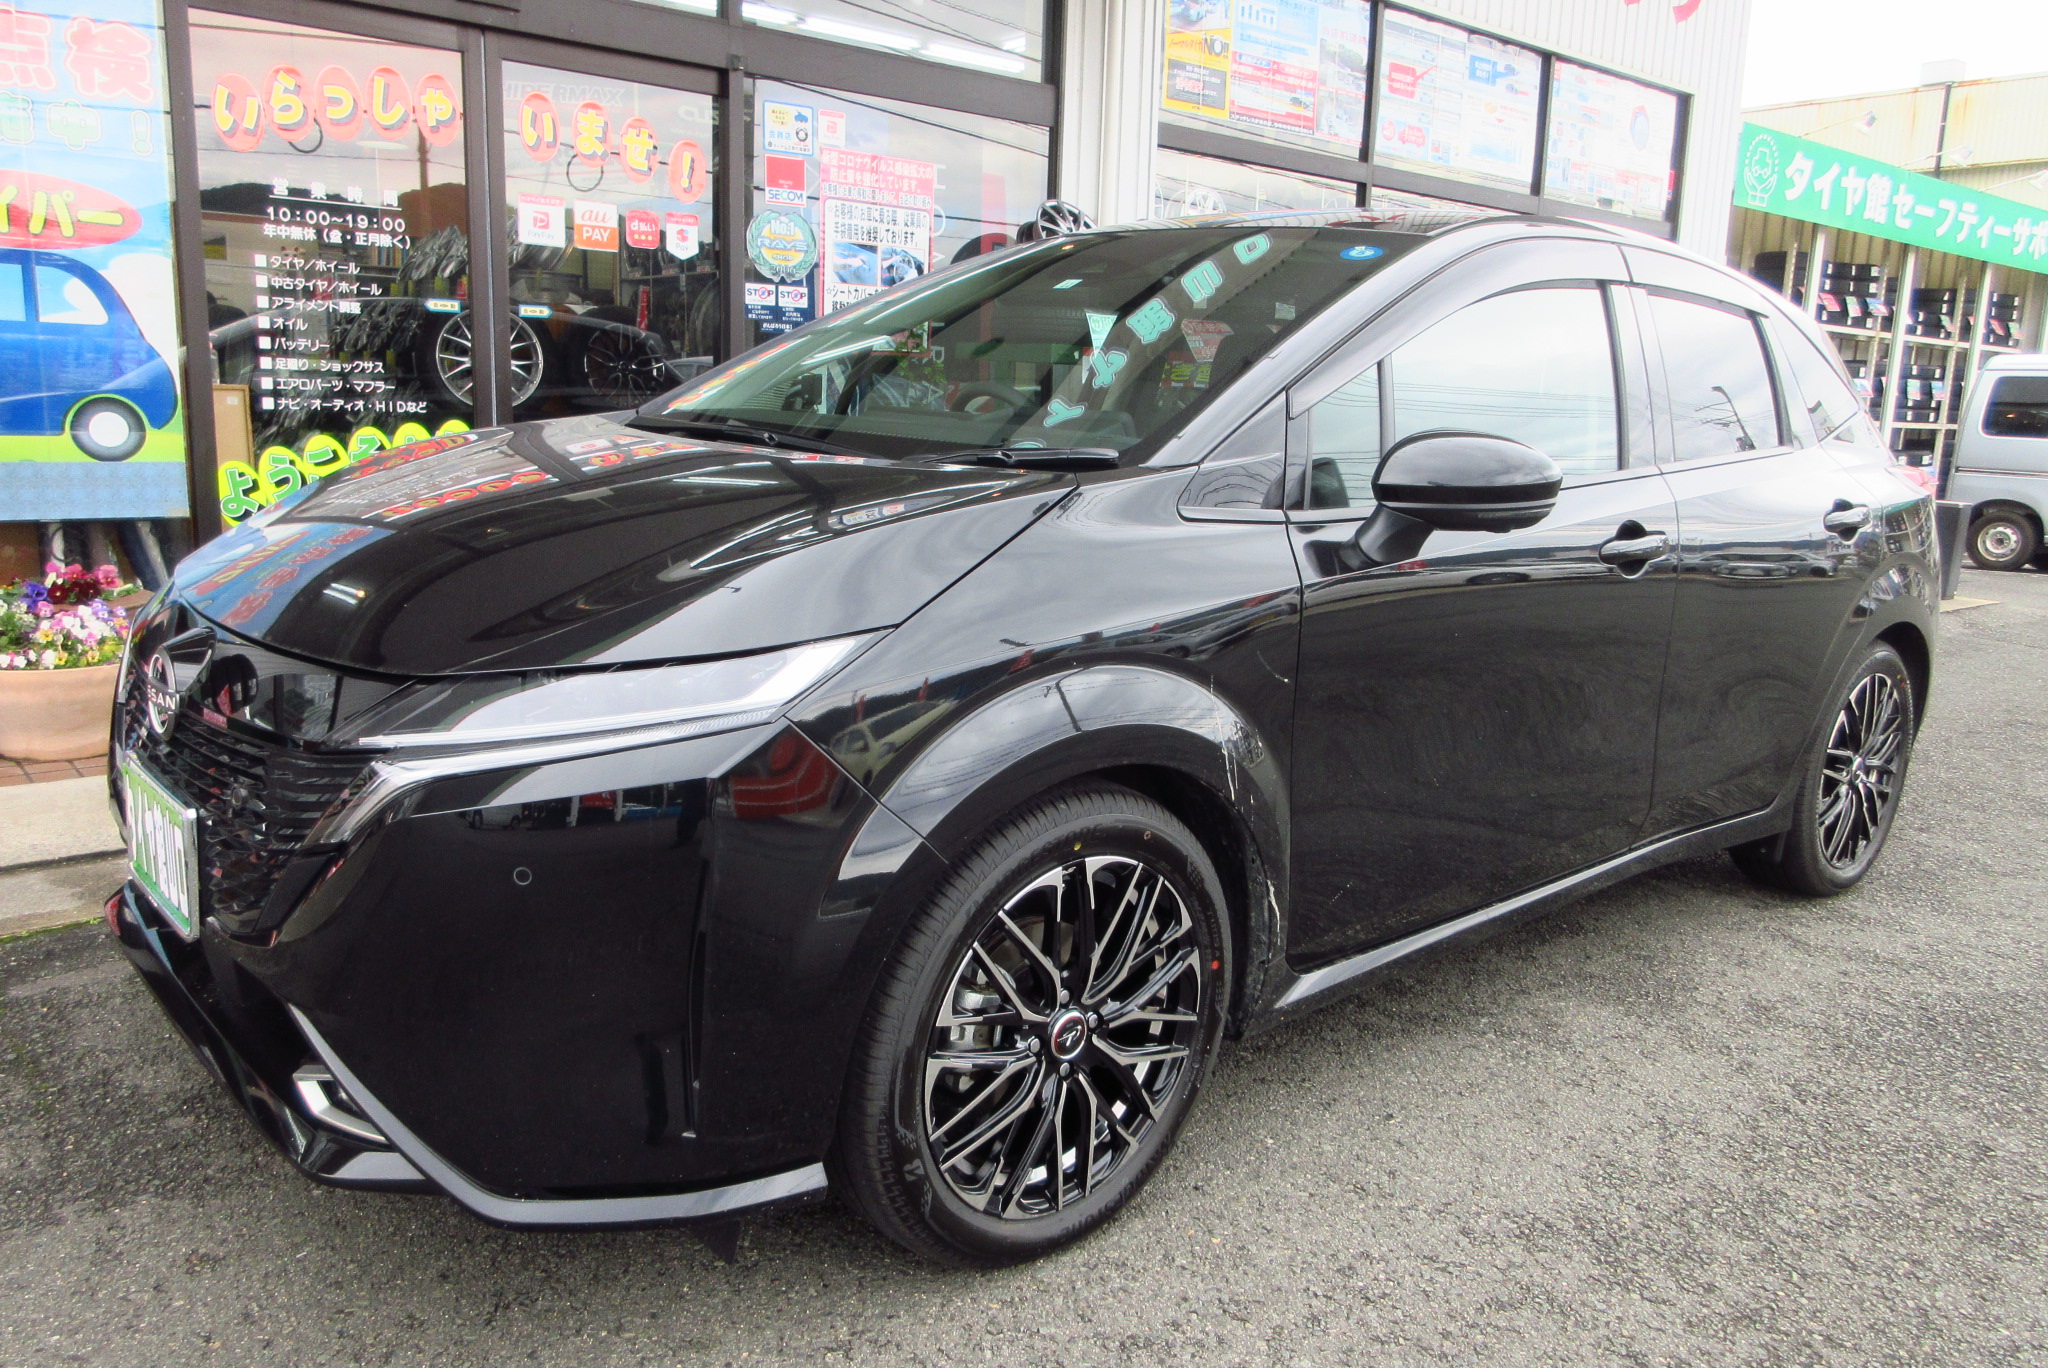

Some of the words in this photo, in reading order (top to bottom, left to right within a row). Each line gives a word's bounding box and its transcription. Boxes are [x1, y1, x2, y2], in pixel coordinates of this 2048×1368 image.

[214, 70, 455, 138] いらっしゃ
[271, 177, 400, 208] 営業時間
[768, 188, 804, 202] SECOM
[581, 208, 612, 223] au
[630, 219, 656, 232] d払い
[527, 229, 555, 242] PayPay
[582, 227, 611, 242] PAY
[675, 242, 690, 252] Pay
[757, 236, 808, 253] RAYS
[772, 253, 795, 262] SHOP
[272, 296, 362, 315] アライメント調整
[273, 317, 308, 331] オイル
[274, 337, 330, 351] バッテリー
[276, 379, 396, 394] エアロパーツ・マフラー
